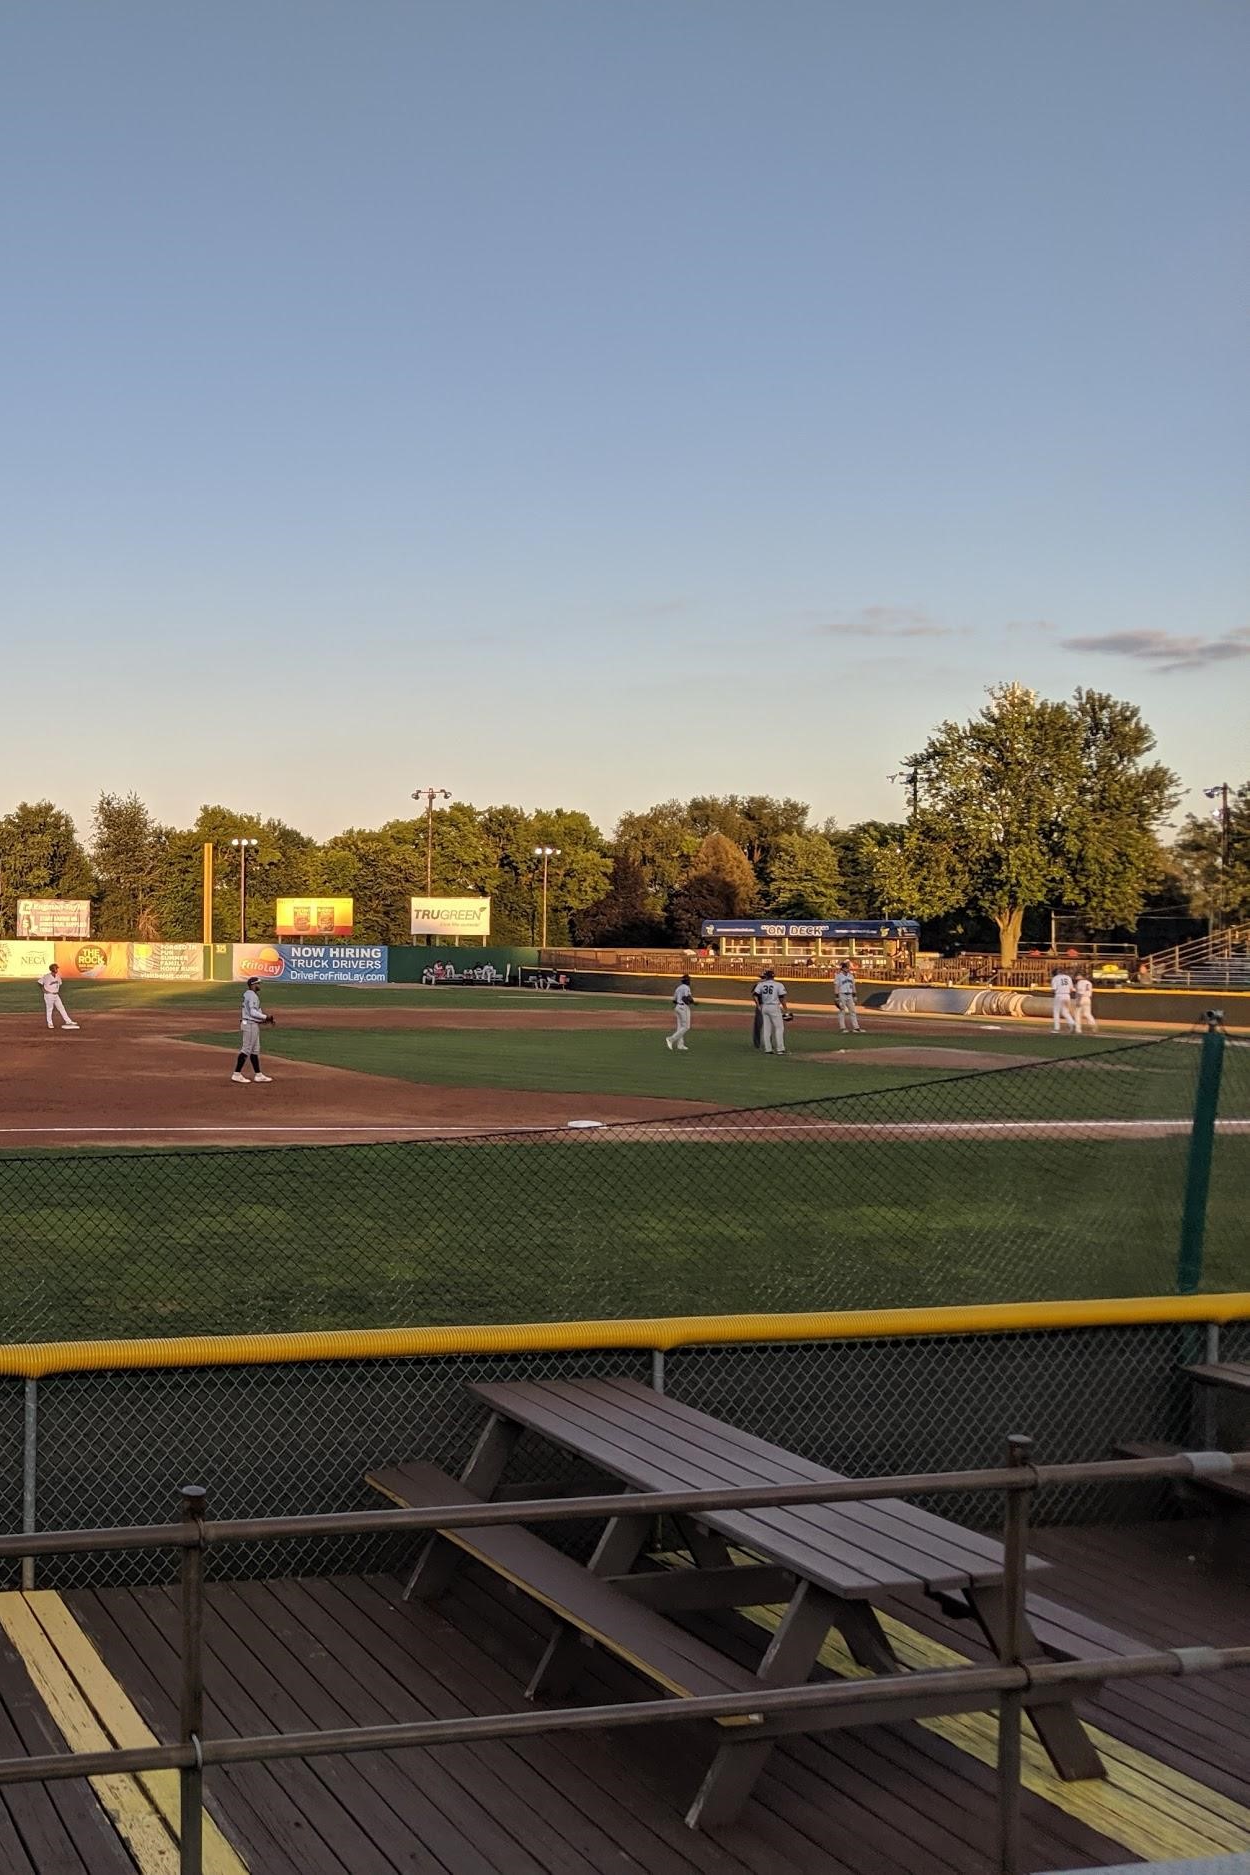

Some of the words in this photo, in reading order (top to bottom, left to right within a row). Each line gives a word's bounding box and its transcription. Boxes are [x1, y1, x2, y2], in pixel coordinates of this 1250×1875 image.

[414, 909, 482, 921] TRUGREEN
[291, 948, 324, 958] NOW
[329, 948, 382, 959] HIRING
[21, 956, 46, 964] NECA
[78, 955, 104, 964] ROCK
[291, 959, 329, 968] TRUCK
[332, 960, 381, 969] DRIVERS
[241, 959, 262, 970] Frito
[263, 963, 280, 974] Lay
[290, 971, 385, 982] DriveForFritoLay.com
[762, 985, 774, 994] 36
